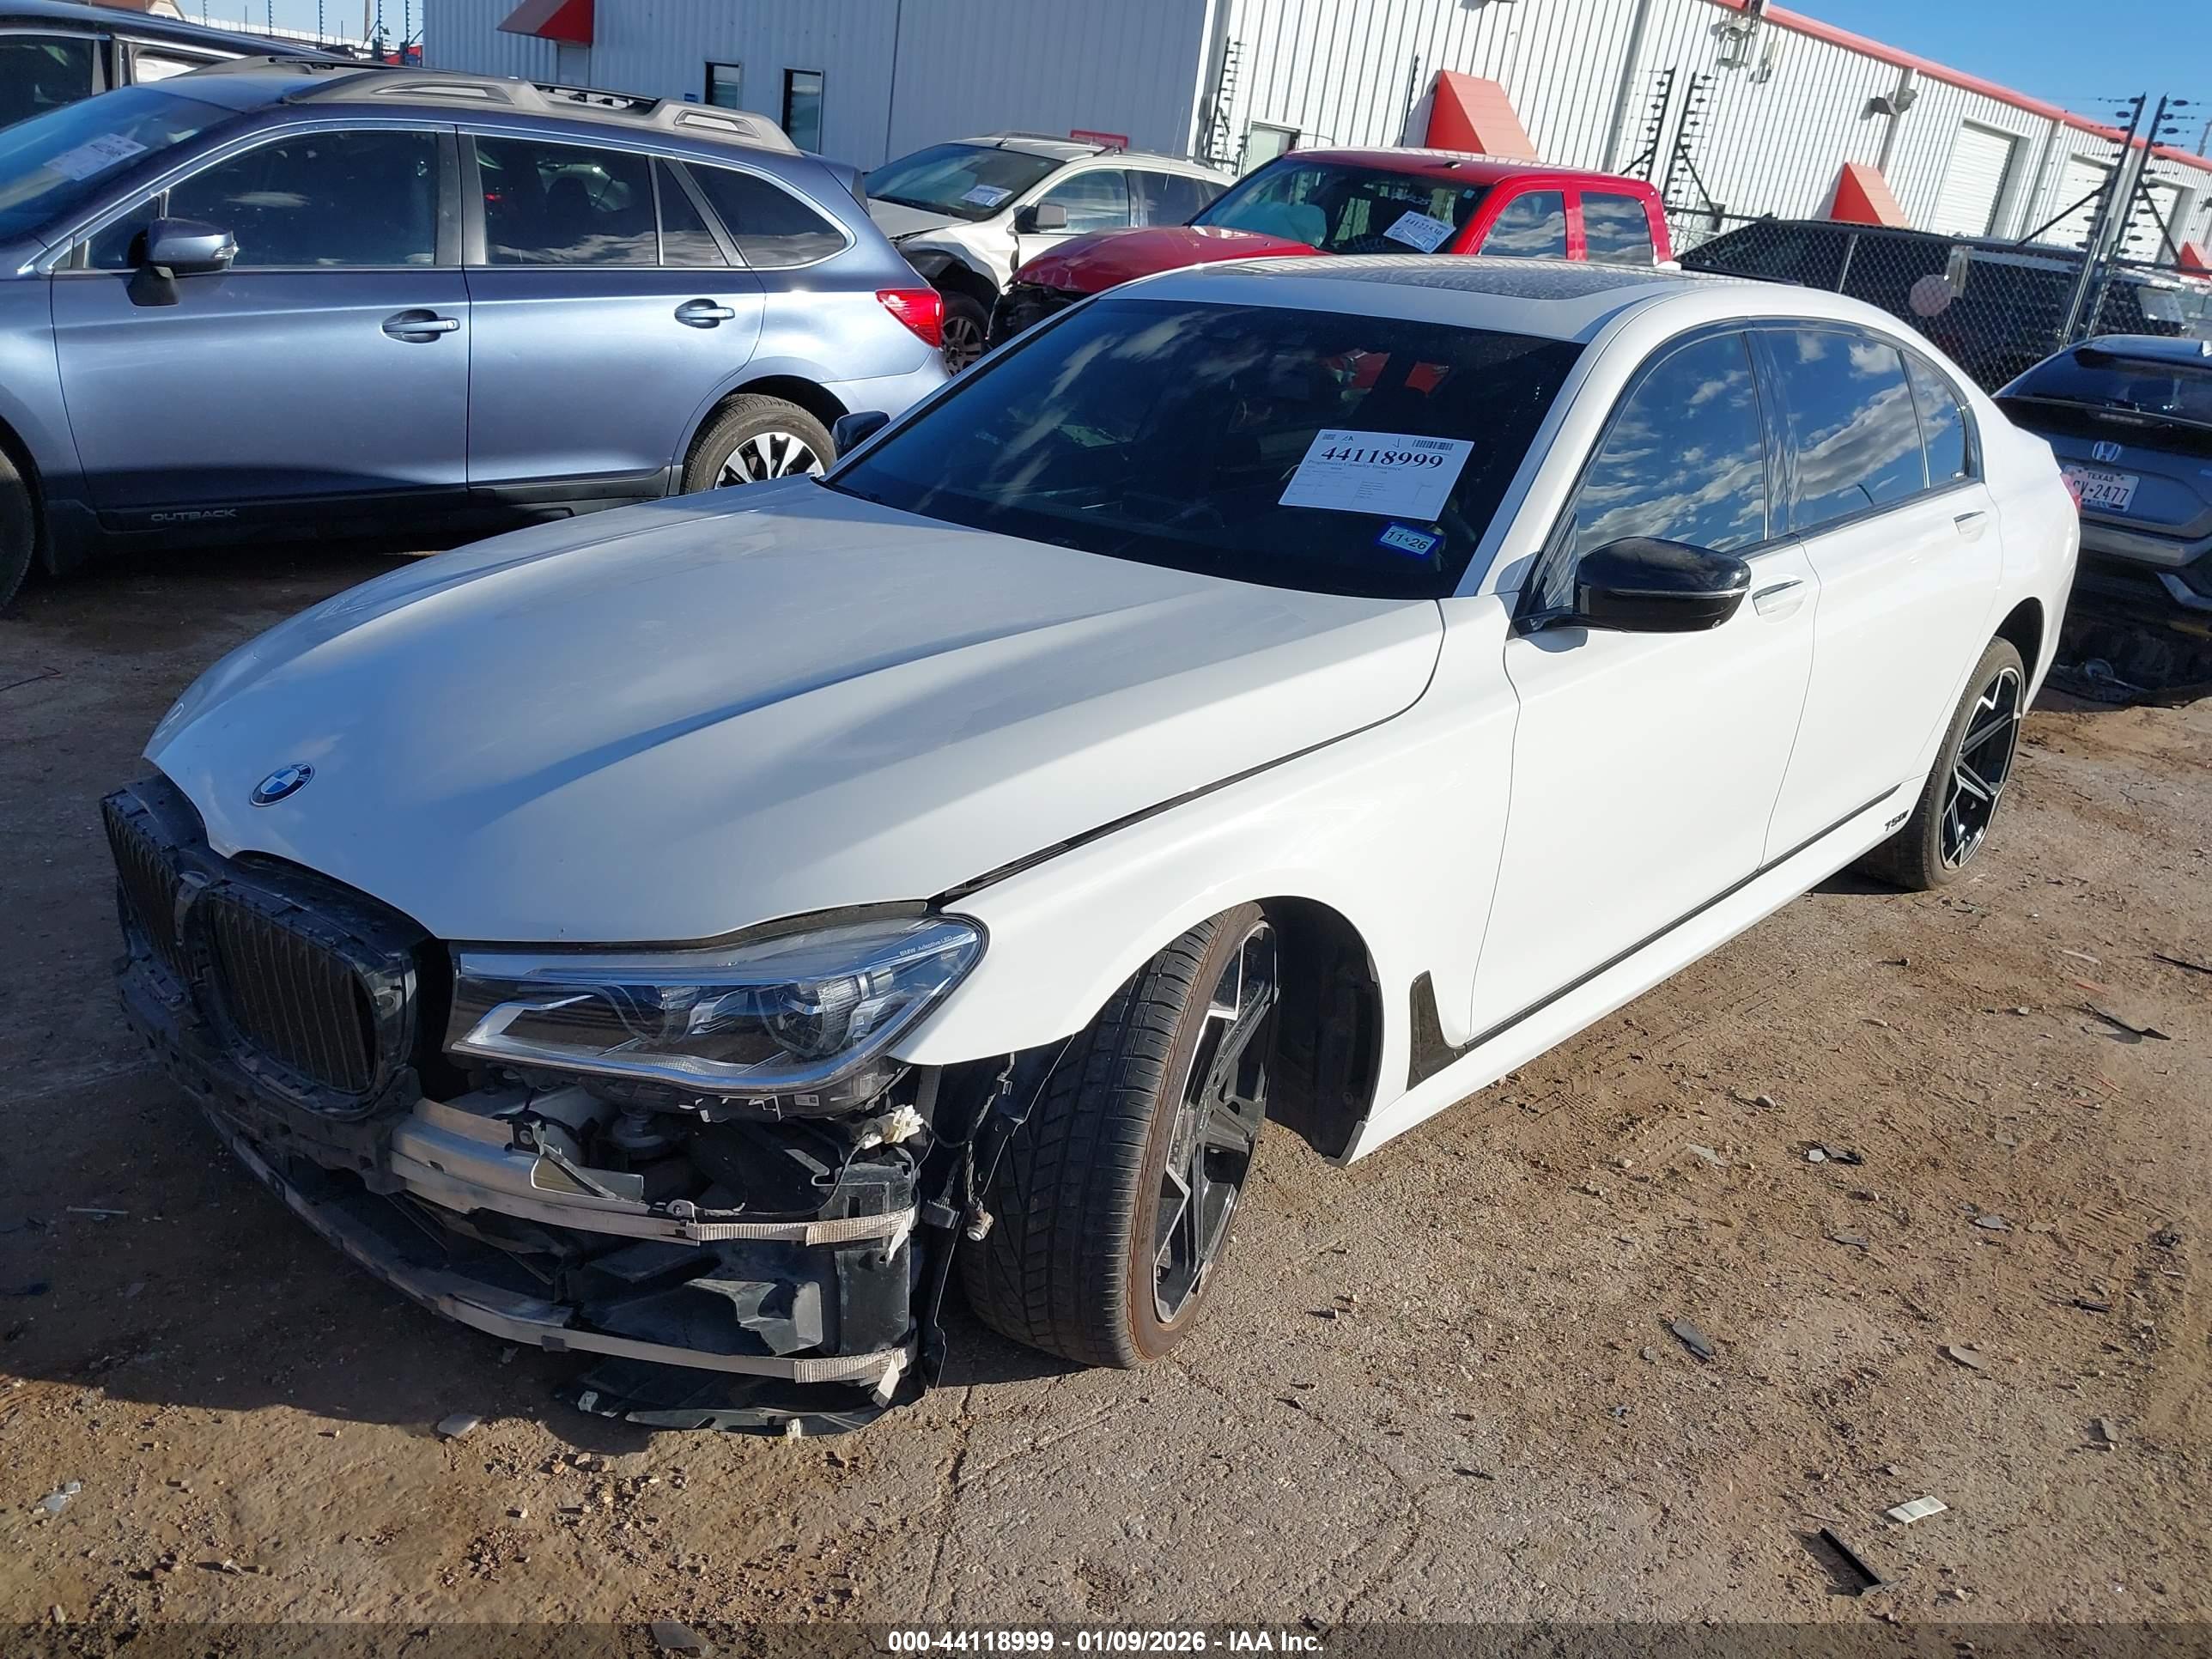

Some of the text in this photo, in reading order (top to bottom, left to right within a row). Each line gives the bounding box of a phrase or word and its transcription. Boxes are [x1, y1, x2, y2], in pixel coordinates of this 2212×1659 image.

[1321, 446, 1443, 470] 44118999
[2087, 472, 2114, 483] TEXAS
[151, 508, 237, 522] OUTBACK
[899, 947, 916, 957] BMW
